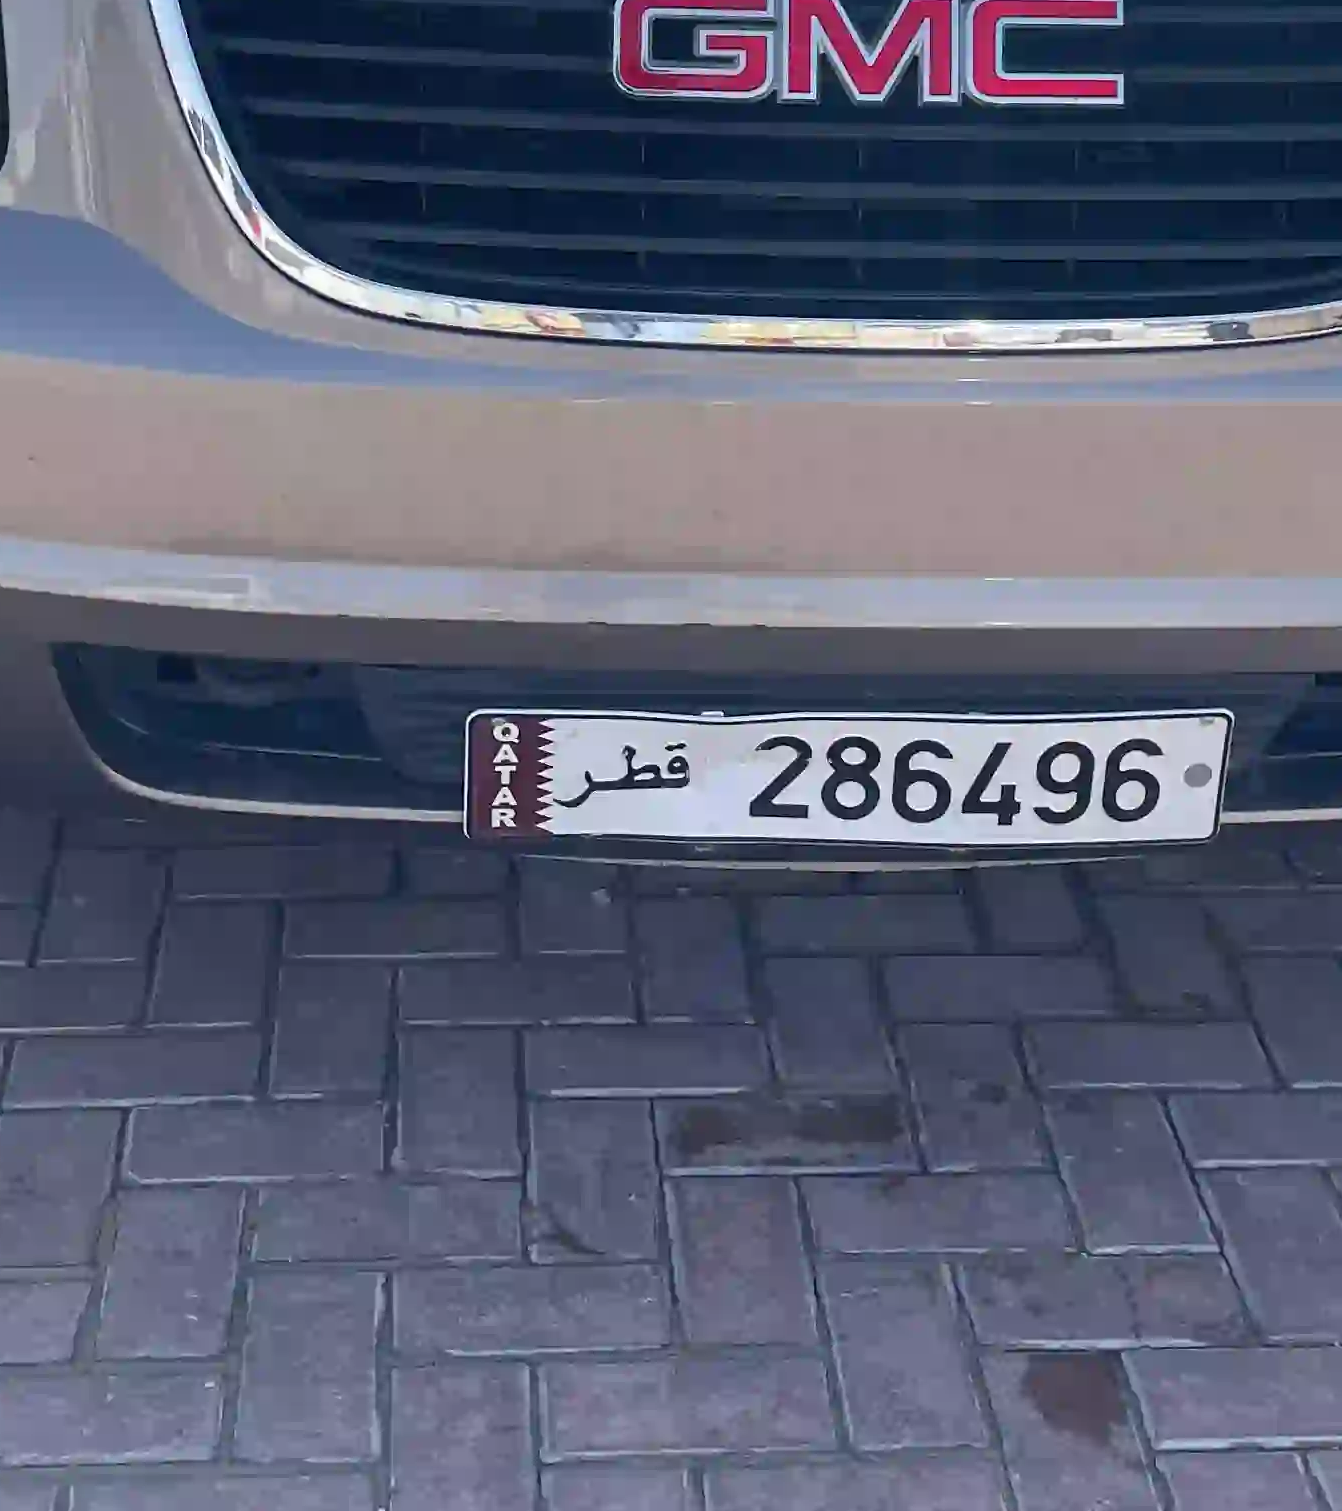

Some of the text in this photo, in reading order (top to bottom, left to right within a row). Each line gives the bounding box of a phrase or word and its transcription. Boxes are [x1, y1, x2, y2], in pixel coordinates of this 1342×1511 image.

[491, 719, 521, 828] QATAR
[553, 741, 691, 808] قطر
[748, 735, 1165, 826] 286496
